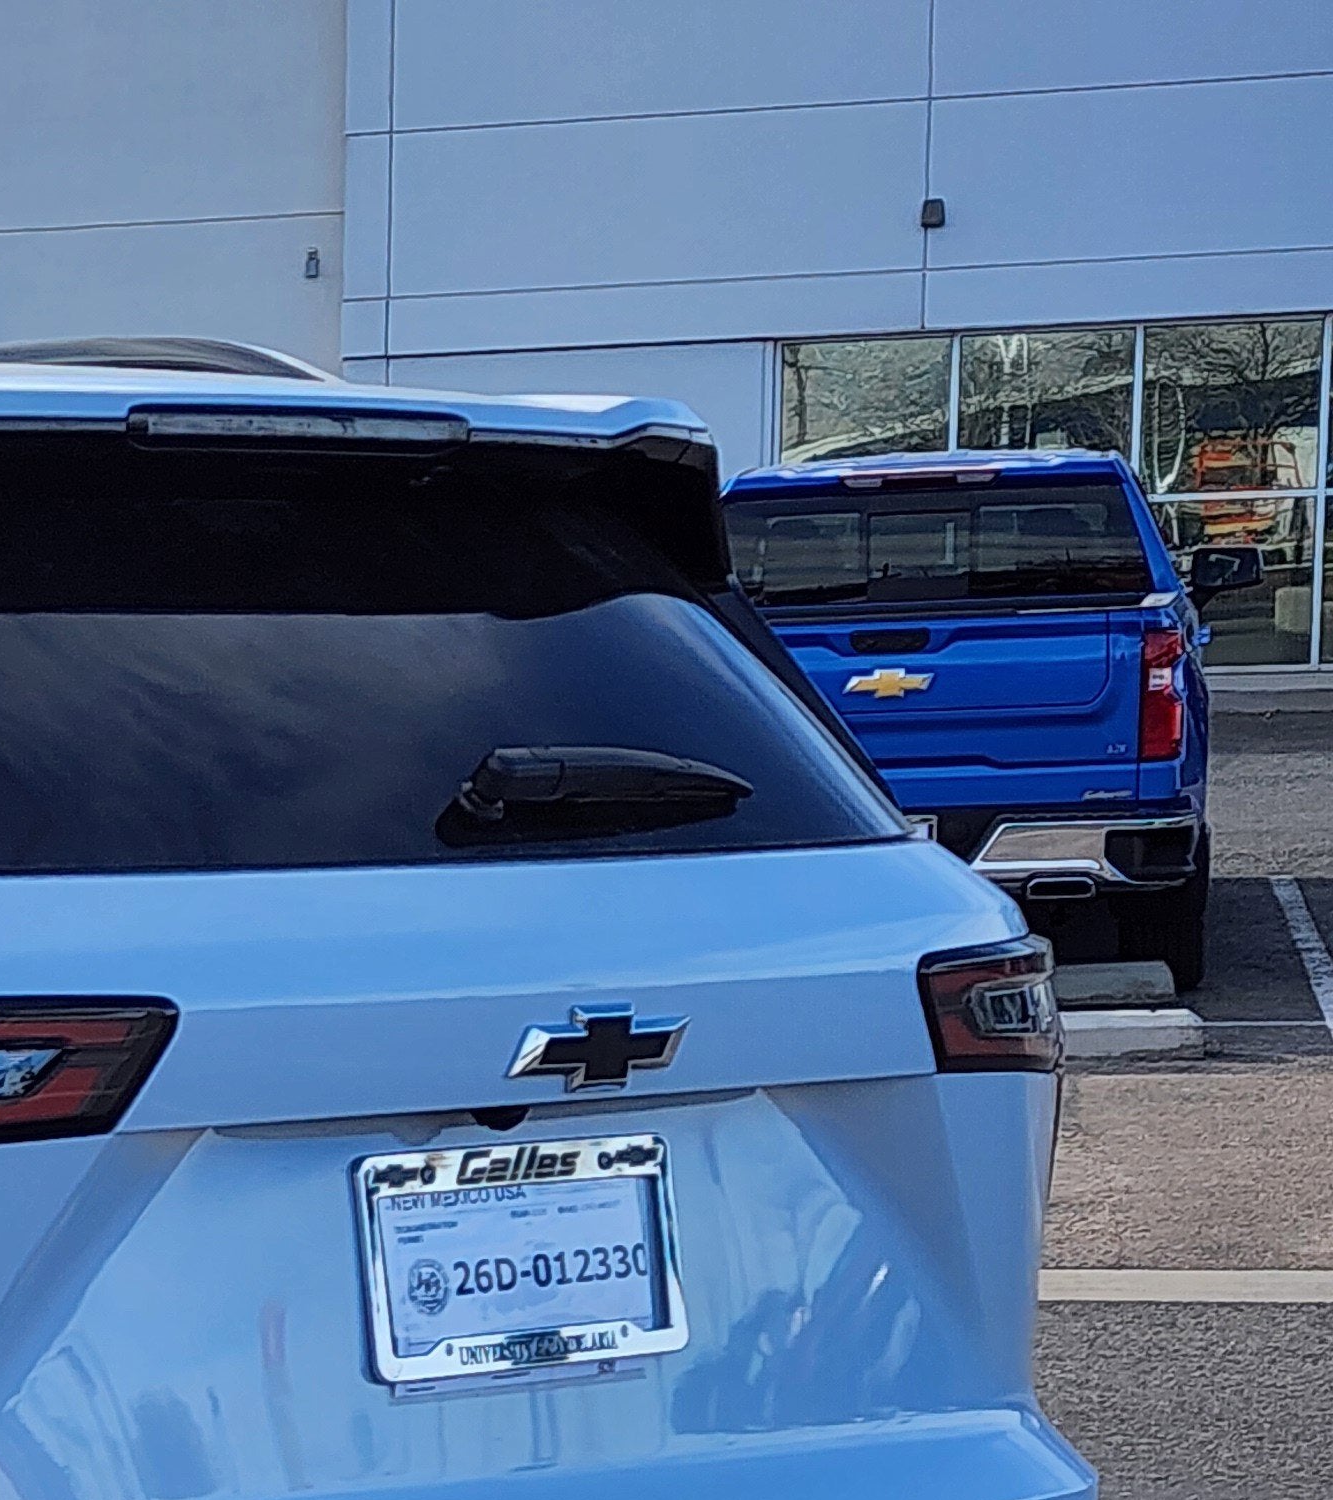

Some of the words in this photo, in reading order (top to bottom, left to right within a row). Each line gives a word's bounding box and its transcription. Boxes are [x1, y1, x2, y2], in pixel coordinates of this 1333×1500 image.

[455, 1145, 582, 1186] Galles
[494, 1184, 527, 1201] USA
[453, 1242, 648, 1296] 26D-012330
